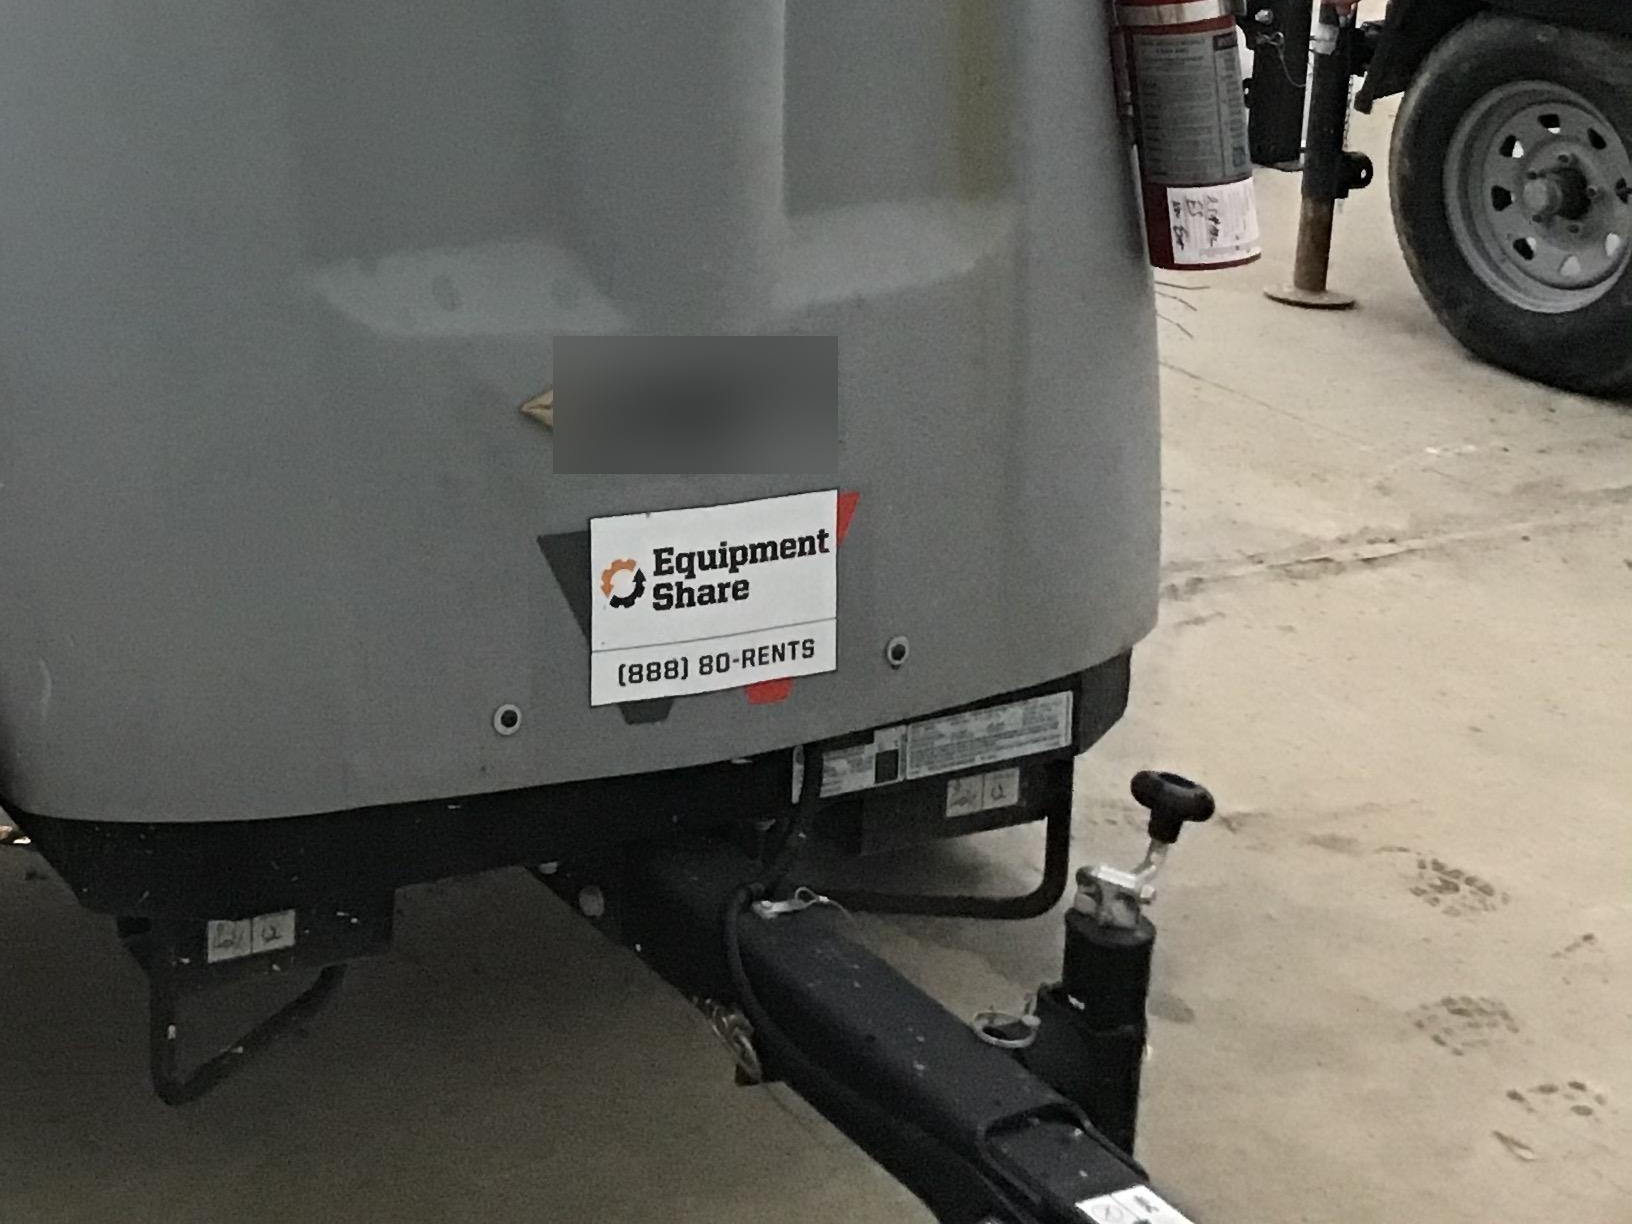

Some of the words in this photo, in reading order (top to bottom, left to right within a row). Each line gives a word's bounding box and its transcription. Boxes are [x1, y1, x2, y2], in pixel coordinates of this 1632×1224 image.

[652, 528, 830, 580] Equipment
[651, 578, 750, 612] Share
[618, 656, 689, 687] (888)
[698, 638, 816, 677] 80-RENTS
